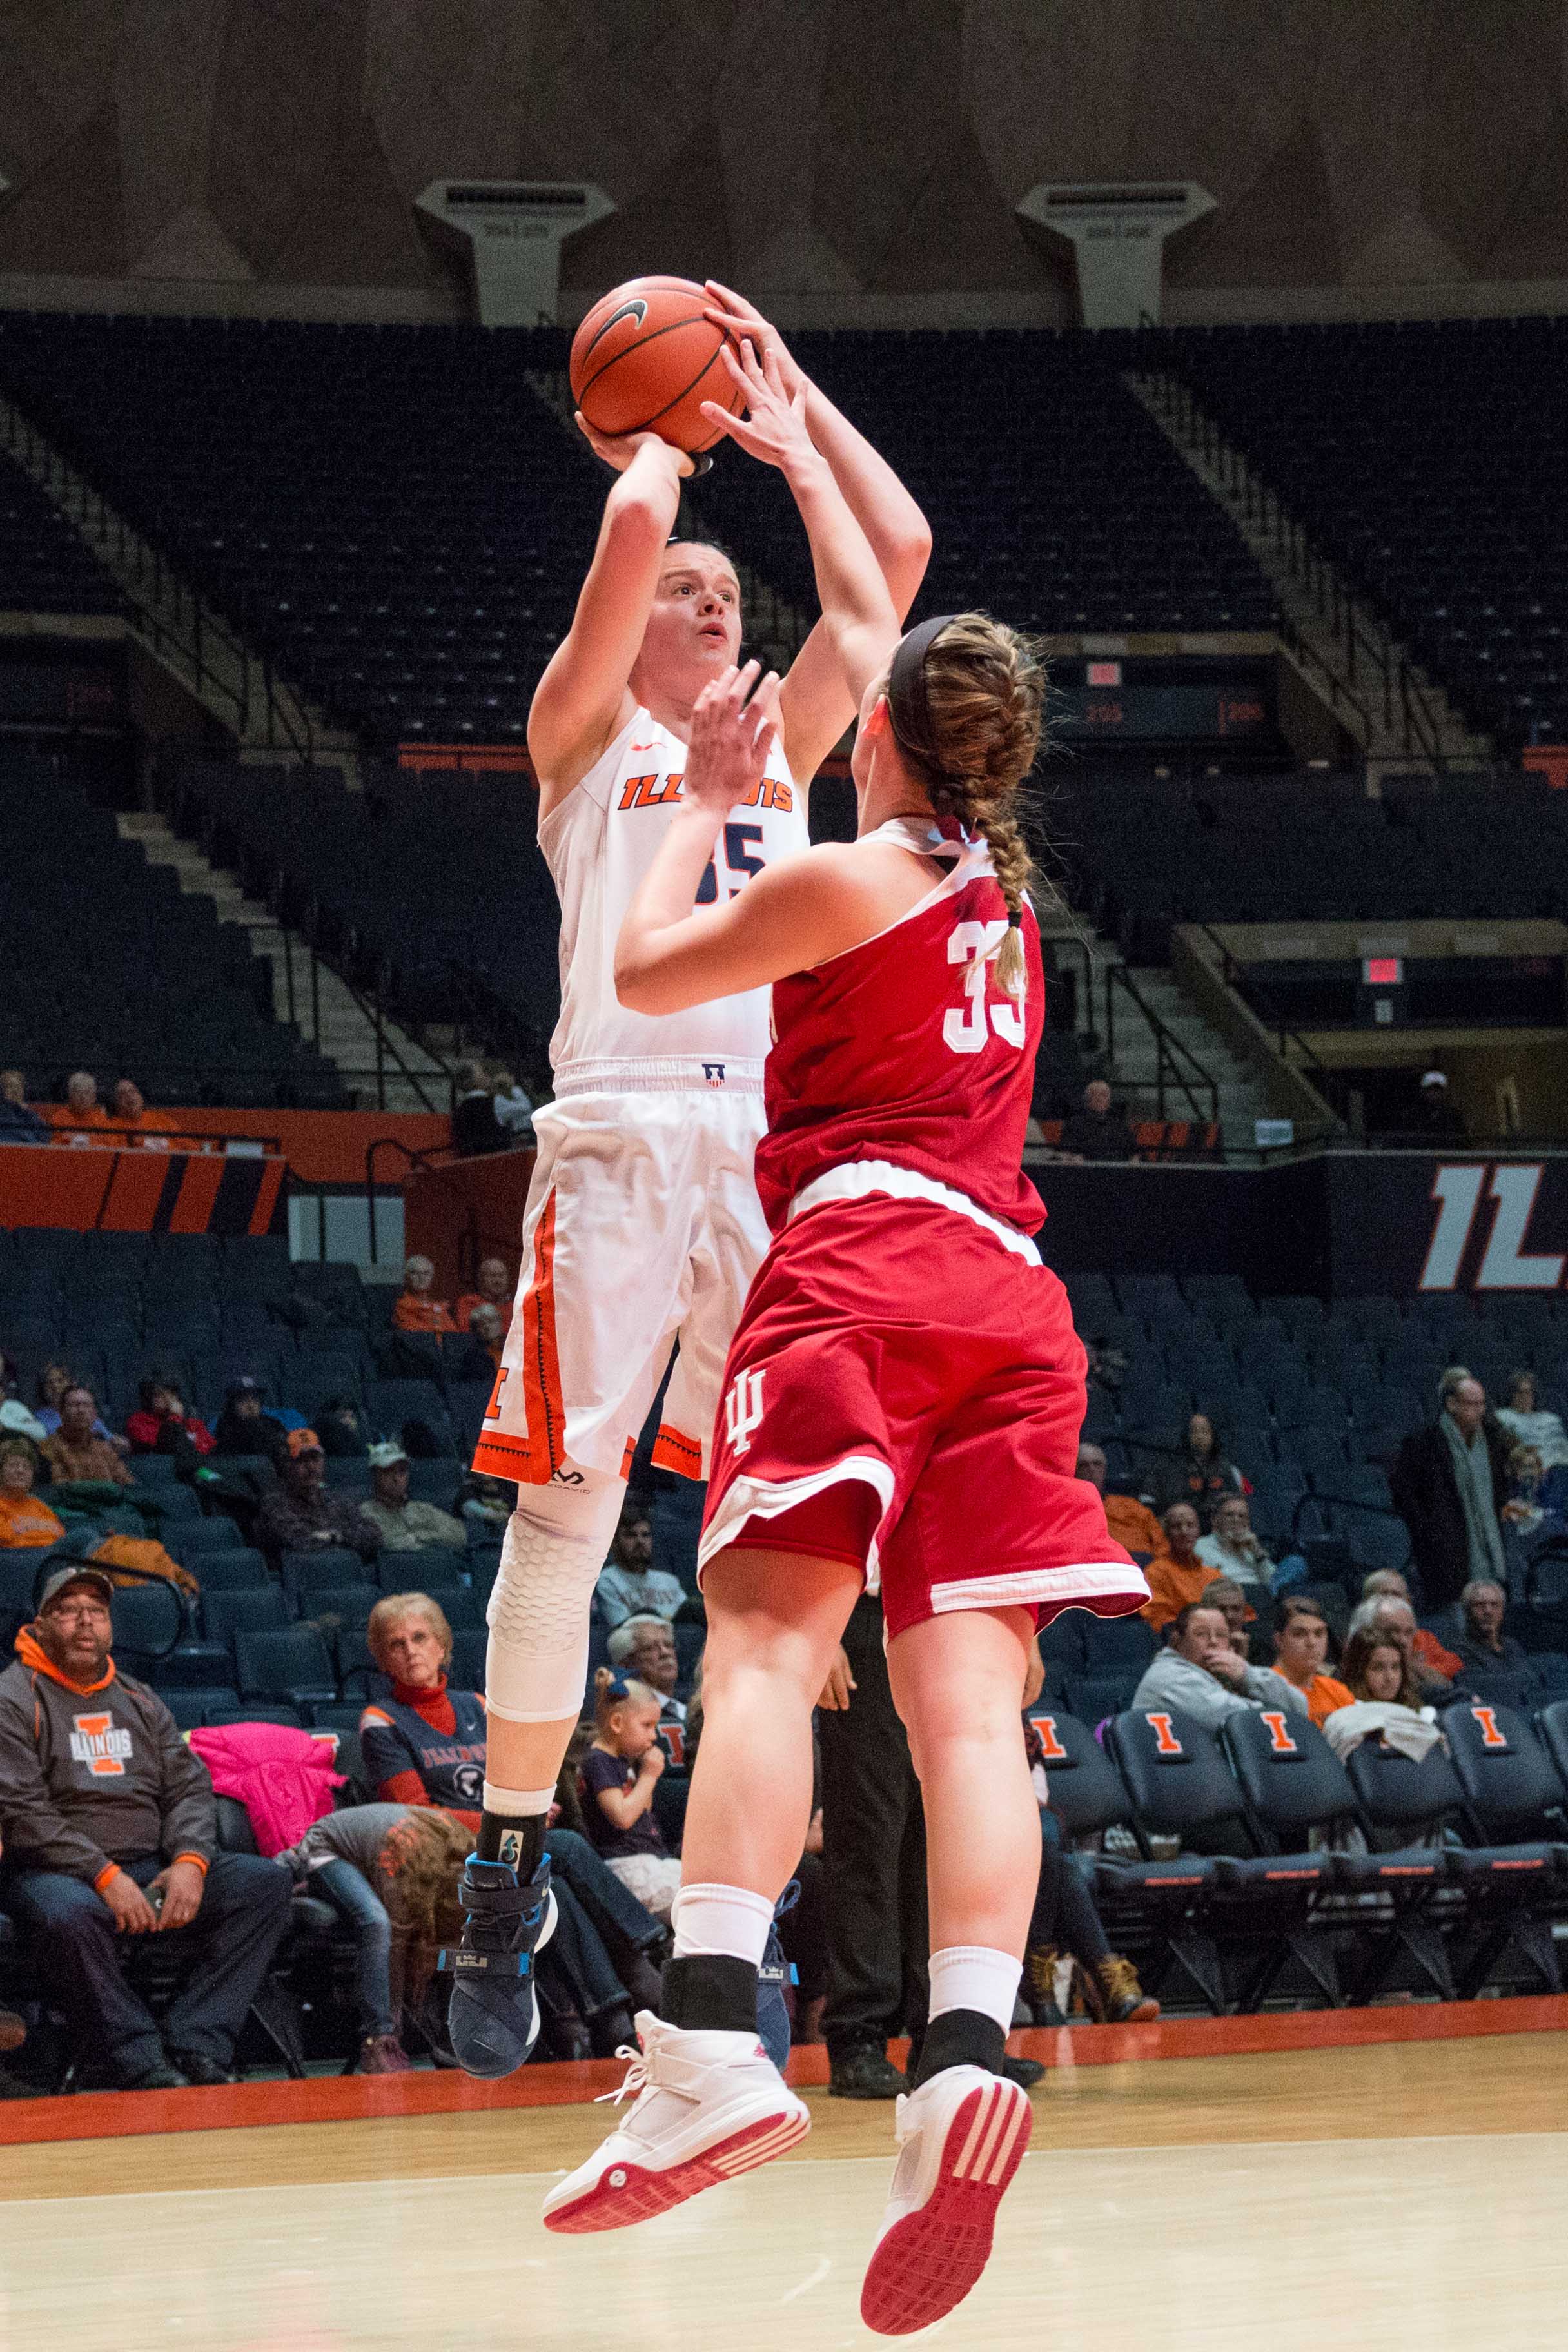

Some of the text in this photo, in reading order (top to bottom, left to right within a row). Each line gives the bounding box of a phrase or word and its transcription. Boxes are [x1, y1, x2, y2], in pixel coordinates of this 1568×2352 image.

[943, 919, 1026, 1054] 33
[69, 1729, 133, 1761] ILLINOIS
[1030, 1716, 1067, 1759] I
[1145, 1712, 1183, 1754] I
[1260, 1712, 1298, 1752] I
[1471, 1707, 1507, 1747] I
